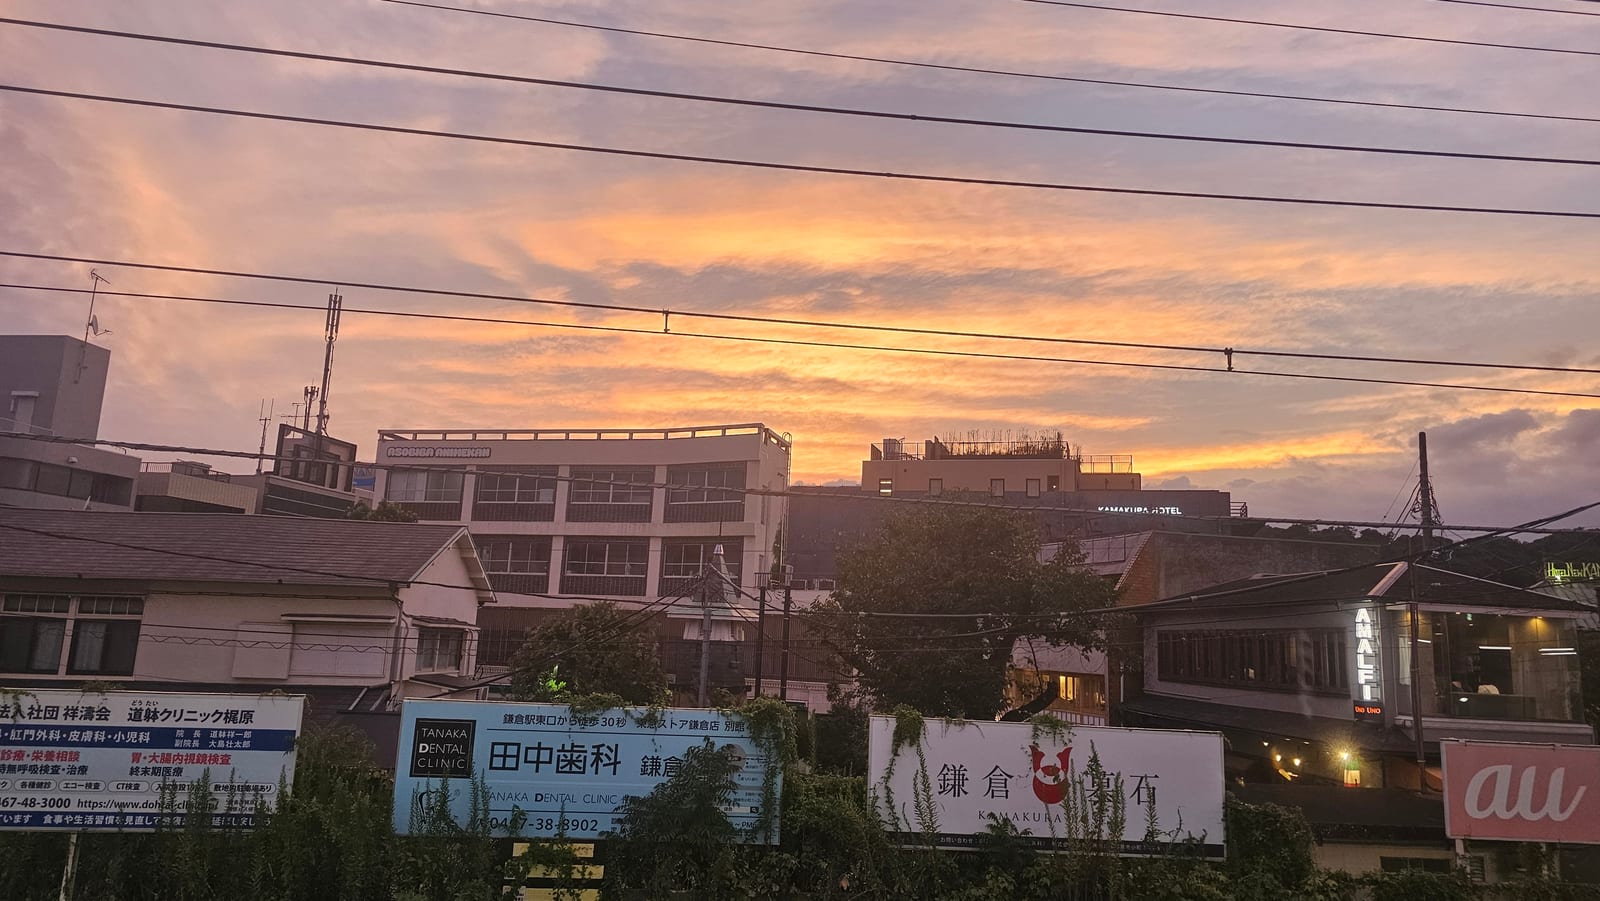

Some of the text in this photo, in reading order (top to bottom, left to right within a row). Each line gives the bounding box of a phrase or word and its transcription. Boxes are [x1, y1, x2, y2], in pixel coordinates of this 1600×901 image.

[387, 447, 491, 458] ASOBIBA ANIMEKAN
[1355, 608, 1374, 701] AMALFI
[0, 729, 151, 744] ・肛門外科・皮膚科・小児科
[421, 727, 468, 739] TANAKA
[418, 743, 466, 755] DENTAL
[417, 757, 466, 769] CLINIC
[488, 741, 622, 776] 田中歯科
[116, 783, 141, 791] CT検査
[487, 792, 528, 803] ANAKA
[534, 793, 577, 803] DENTAL
[583, 794, 617, 805] CLINIC
[1465, 765, 1586, 822] au
[0, 797, 71, 809] 67-48-3000
[490, 816, 598, 831] 047-38-8902
